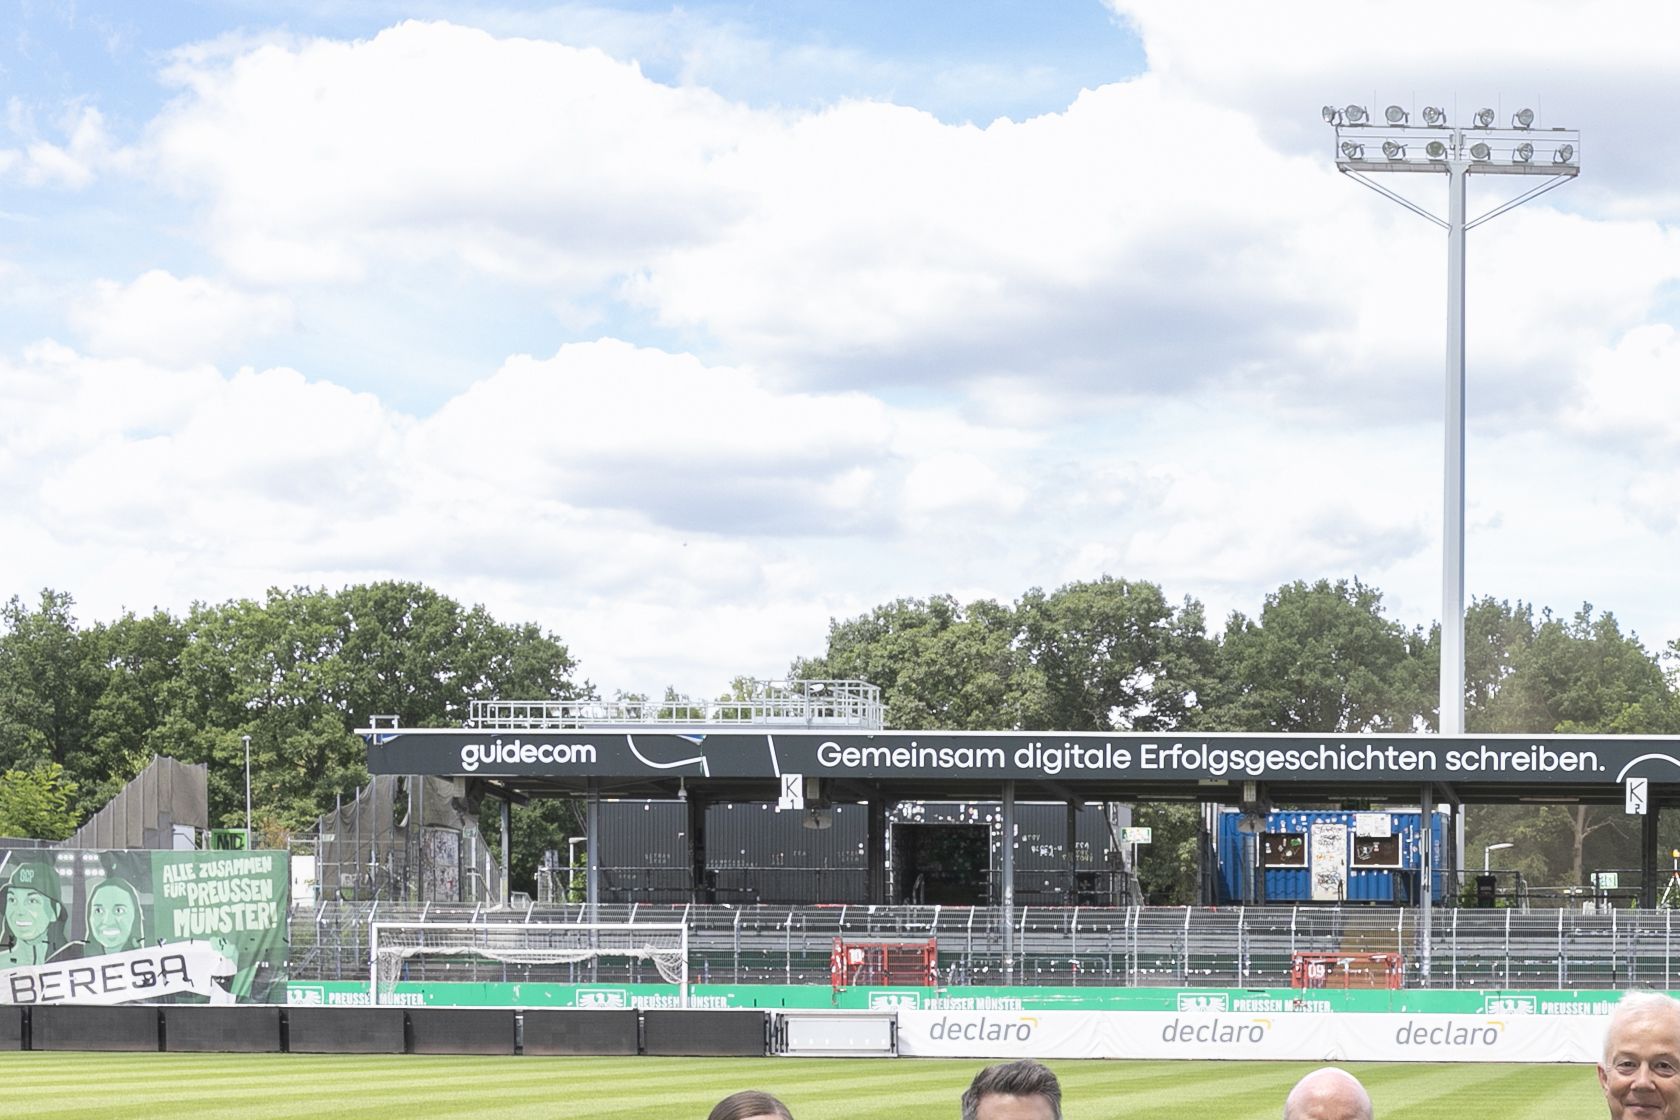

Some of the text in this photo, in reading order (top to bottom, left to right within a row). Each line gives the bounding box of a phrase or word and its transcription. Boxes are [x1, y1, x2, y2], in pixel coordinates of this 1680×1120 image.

[461, 740, 597, 772] guidecom
[817, 741, 1606, 776] Gemeinsam digitale Erfolgsgeschichten schreiben.
[786, 777, 798, 798] K
[1630, 781, 1645, 803] K
[19, 868, 35, 883] SCP
[163, 856, 272, 883] ALLE ZUSAMMEN
[163, 879, 273, 906] FÜR PREUSSEN
[173, 901, 277, 937] MÜNSTER!
[10, 954, 191, 1004] BERESA
[1308, 963, 1325, 978] 09
[328, 992, 371, 1005] PREUSSE
[687, 993, 731, 1009] ÜNSTER.
[1233, 999, 1282, 1012] PREUSSEN
[1541, 1002, 1590, 1014] PREUSSEN
[930, 1017, 1031, 1041] declaro
[1162, 1019, 1264, 1042] declaro
[1396, 1021, 1498, 1045] declaro
